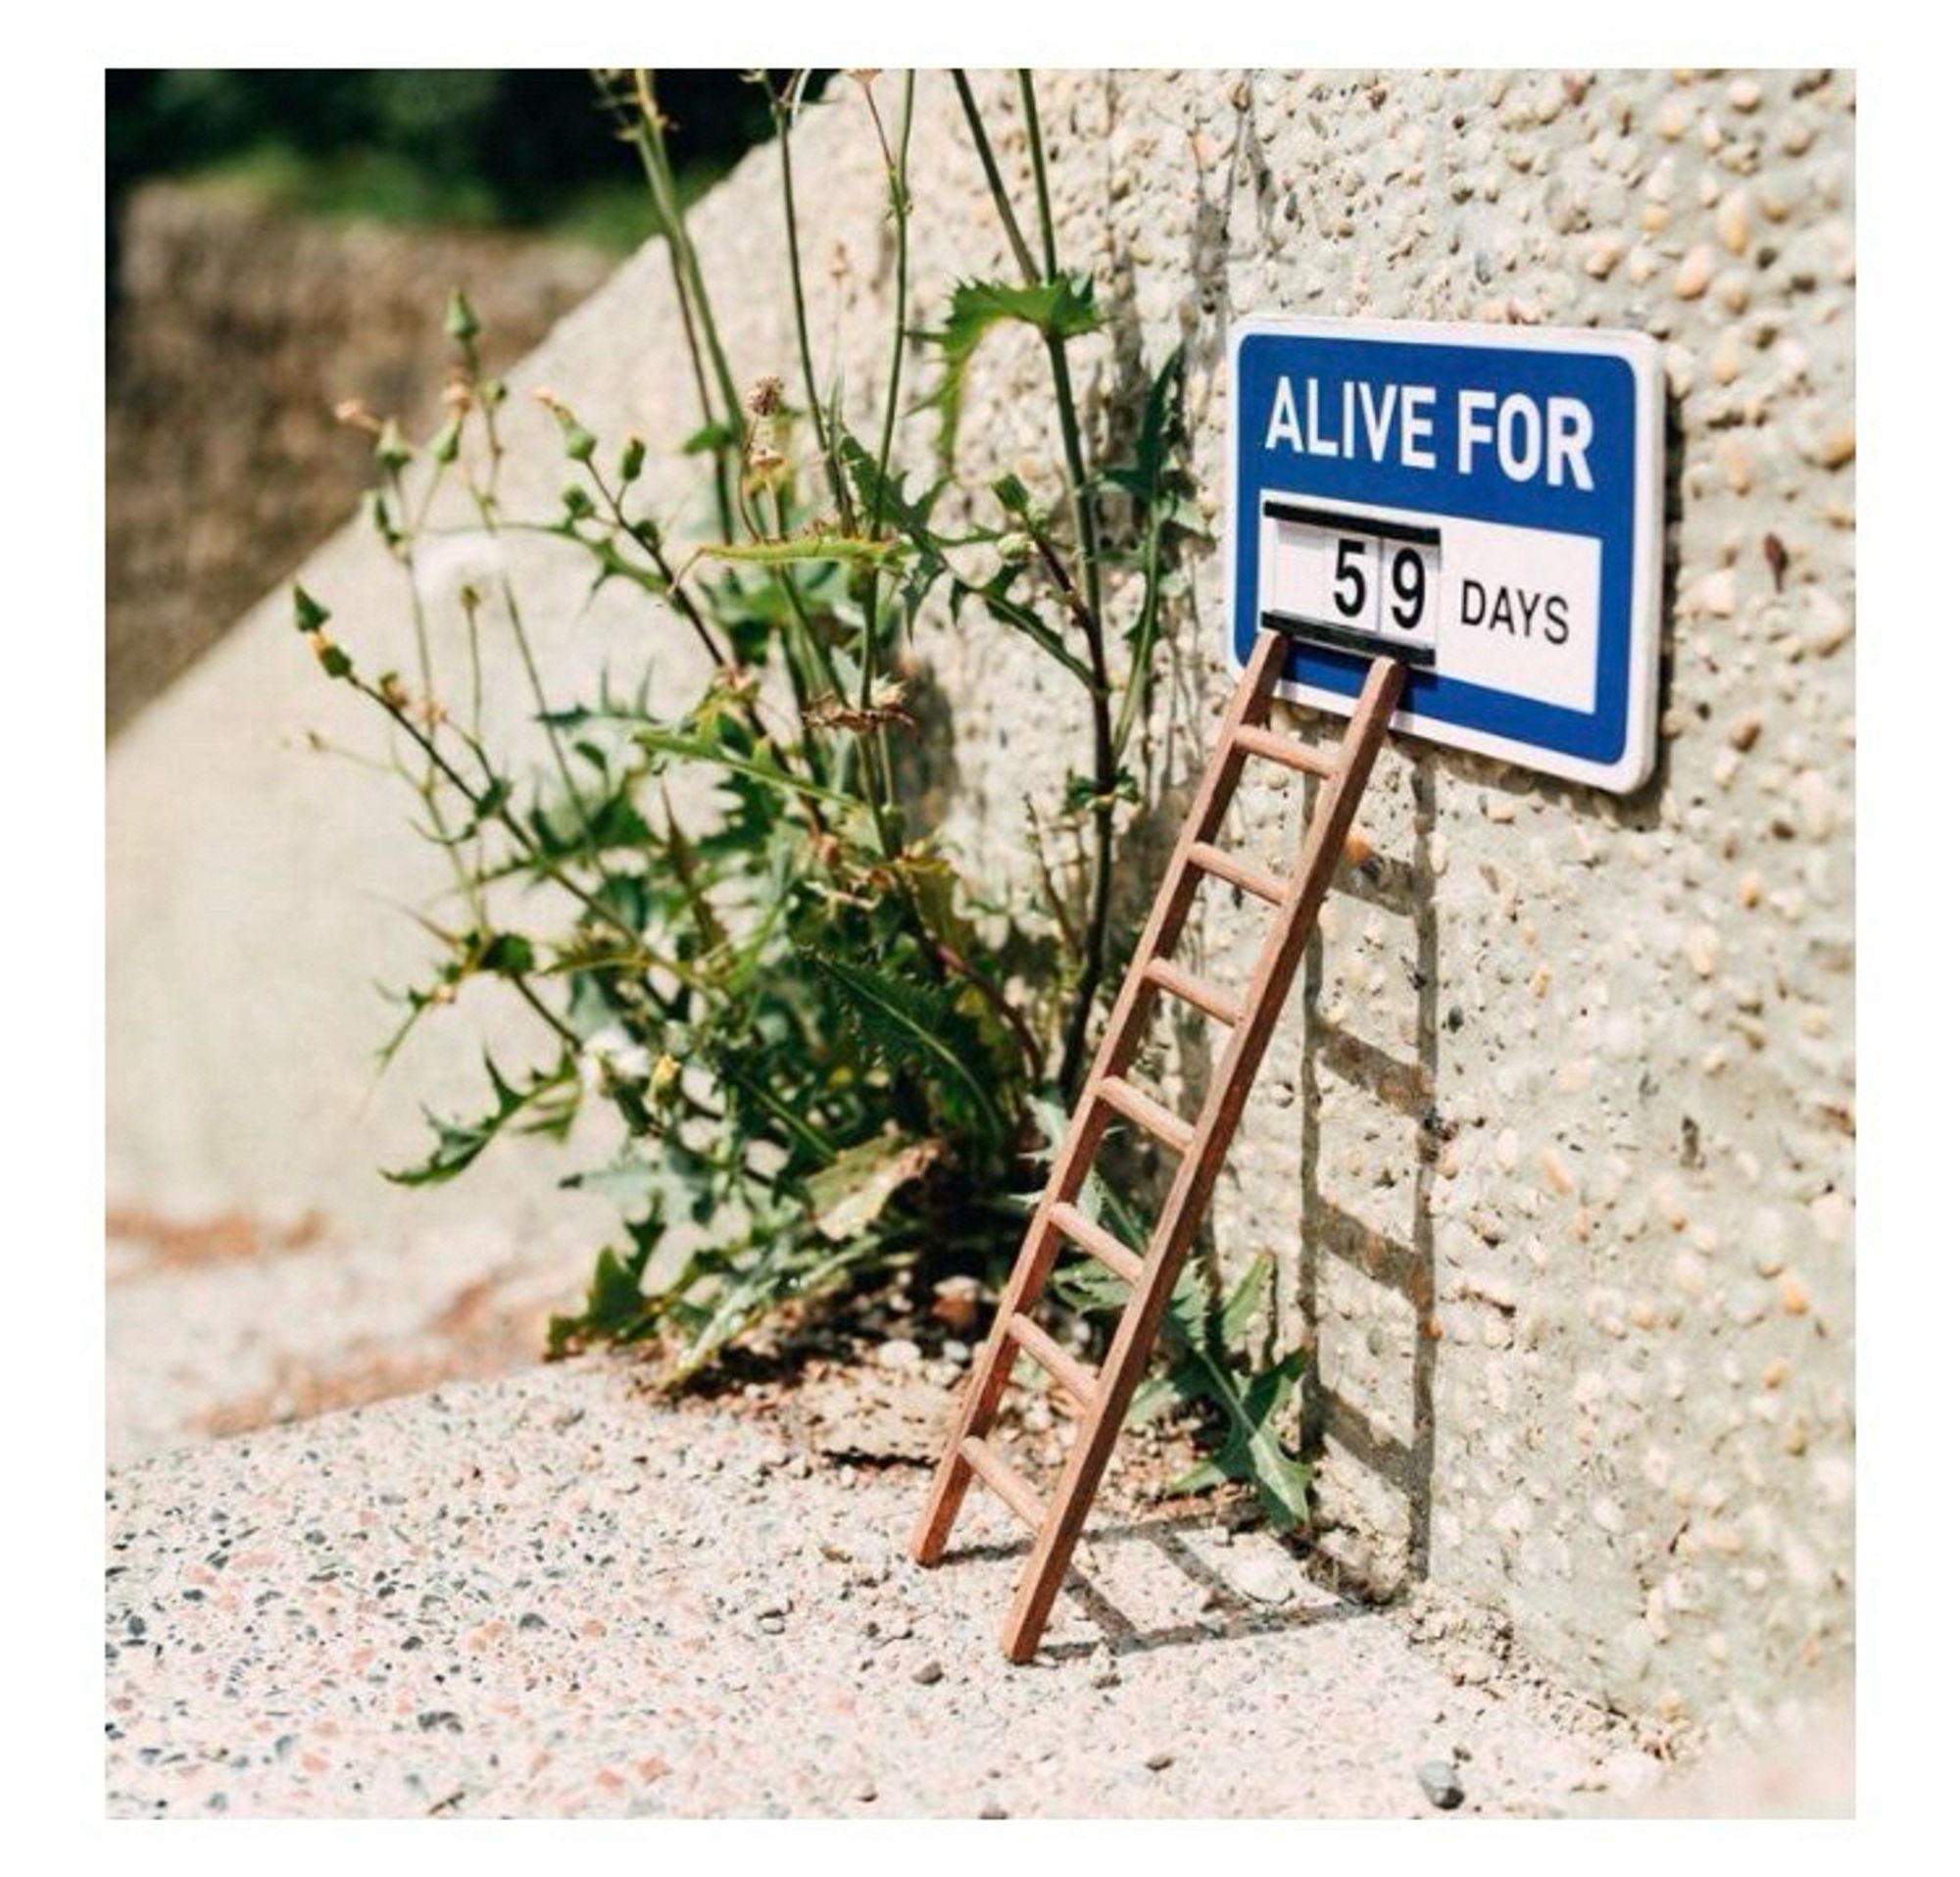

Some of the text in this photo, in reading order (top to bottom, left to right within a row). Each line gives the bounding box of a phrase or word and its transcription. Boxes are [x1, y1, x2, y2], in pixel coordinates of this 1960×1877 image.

[1265, 376, 1594, 491] ALIVE FOR
[1334, 537, 1570, 645] 59 DAYS
